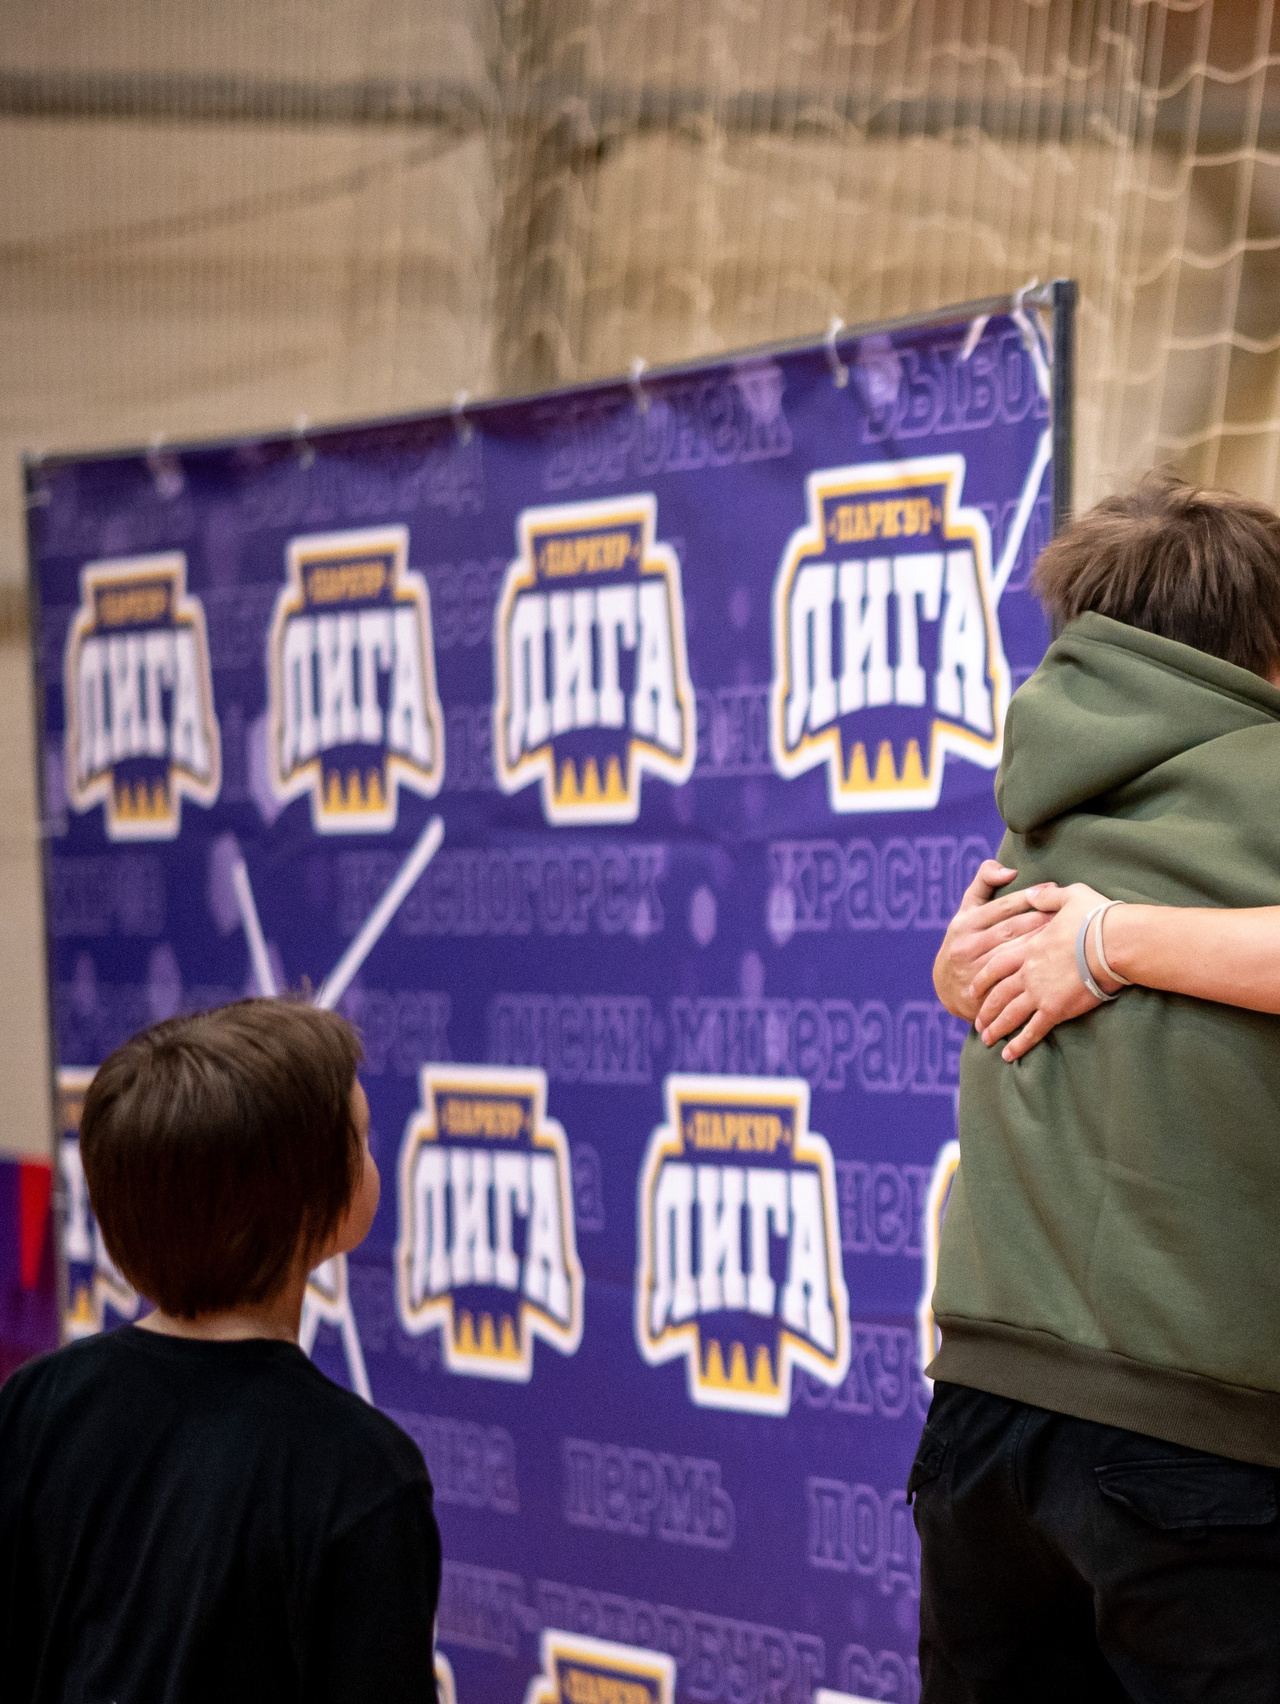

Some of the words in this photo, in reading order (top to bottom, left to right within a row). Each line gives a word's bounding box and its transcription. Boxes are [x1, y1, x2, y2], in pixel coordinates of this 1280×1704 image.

[79, 628, 208, 788] ЛИГА
[281, 607, 436, 783] ЛИГА
[507, 580, 685, 767] ЛИГА
[784, 550, 995, 753] ЛИГА
[412, 1146, 572, 1324] ЛИГА
[650, 1161, 836, 1353] ЛИГА
[564, 1436, 738, 1551] ПЕРМЬ
